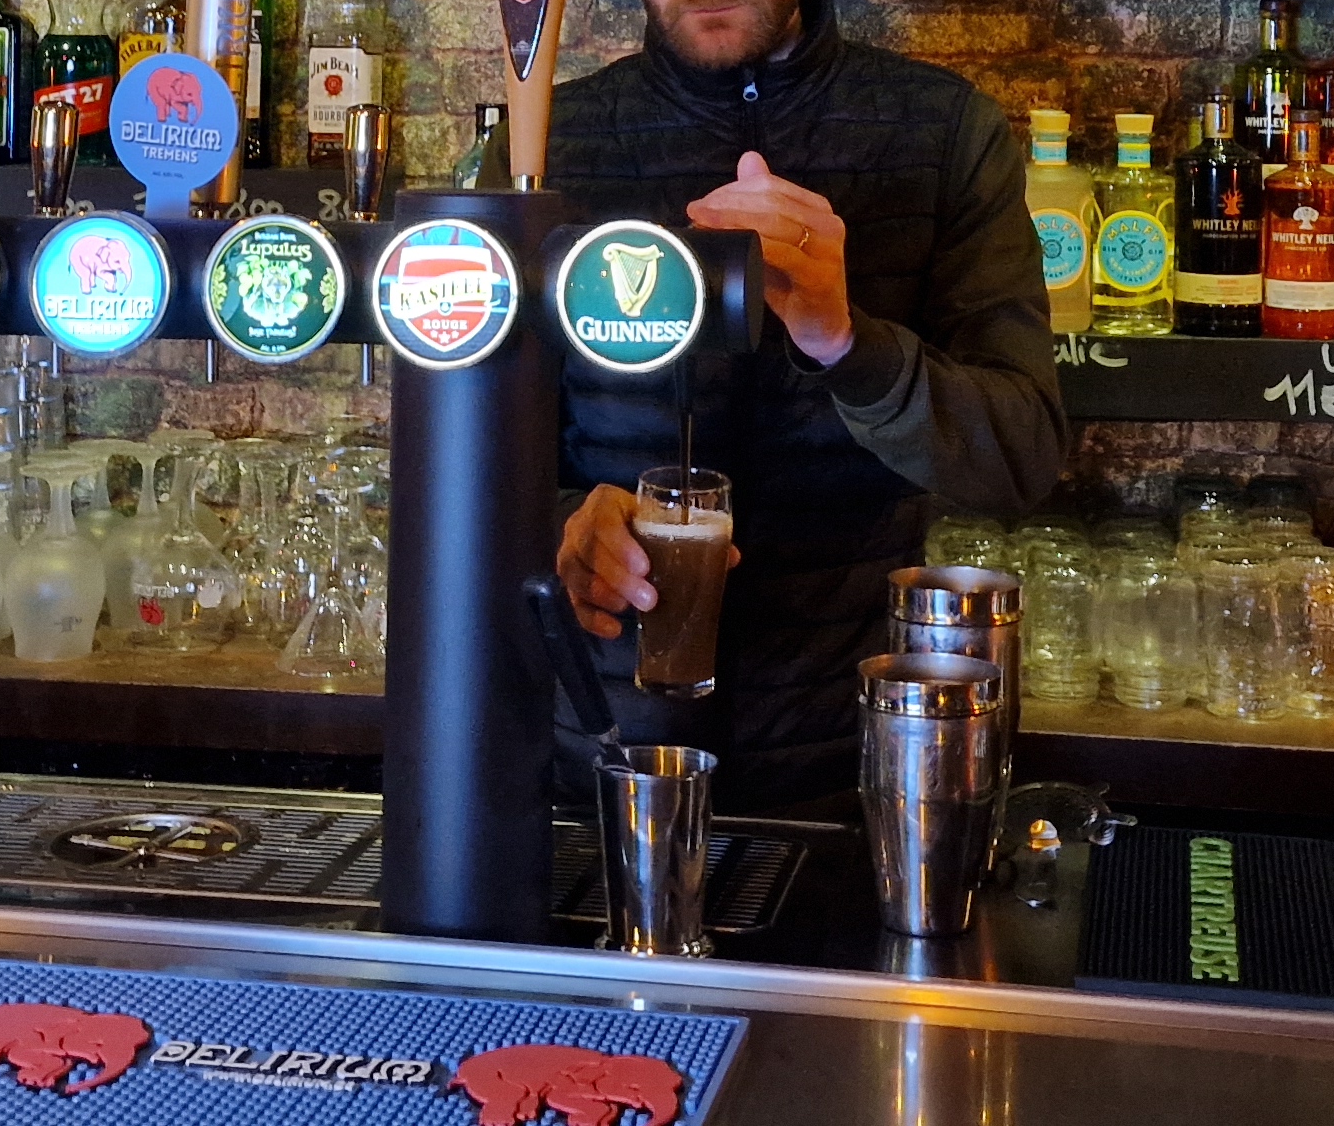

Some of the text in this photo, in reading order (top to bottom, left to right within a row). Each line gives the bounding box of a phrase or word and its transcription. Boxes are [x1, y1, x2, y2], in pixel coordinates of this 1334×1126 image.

[310, 57, 359, 80] JIM BEAM
[79, 82, 104, 104] 27
[120, 120, 222, 152] DELIRIUM
[142, 146, 199, 164] TREMENS
[1107, 219, 1161, 242] MALFY
[1192, 218, 1239, 232] WHITLEY
[1271, 232, 1314, 245] WHITLEY
[44, 293, 155, 320] DELIRIUM
[399, 279, 488, 313] KASTEEL
[422, 318, 468, 332] ROUGE
[575, 315, 689, 344] GUINNESS
[1188, 836, 1240, 982] CHARTREUSE
[150, 1039, 432, 1083] DELIRIUM
